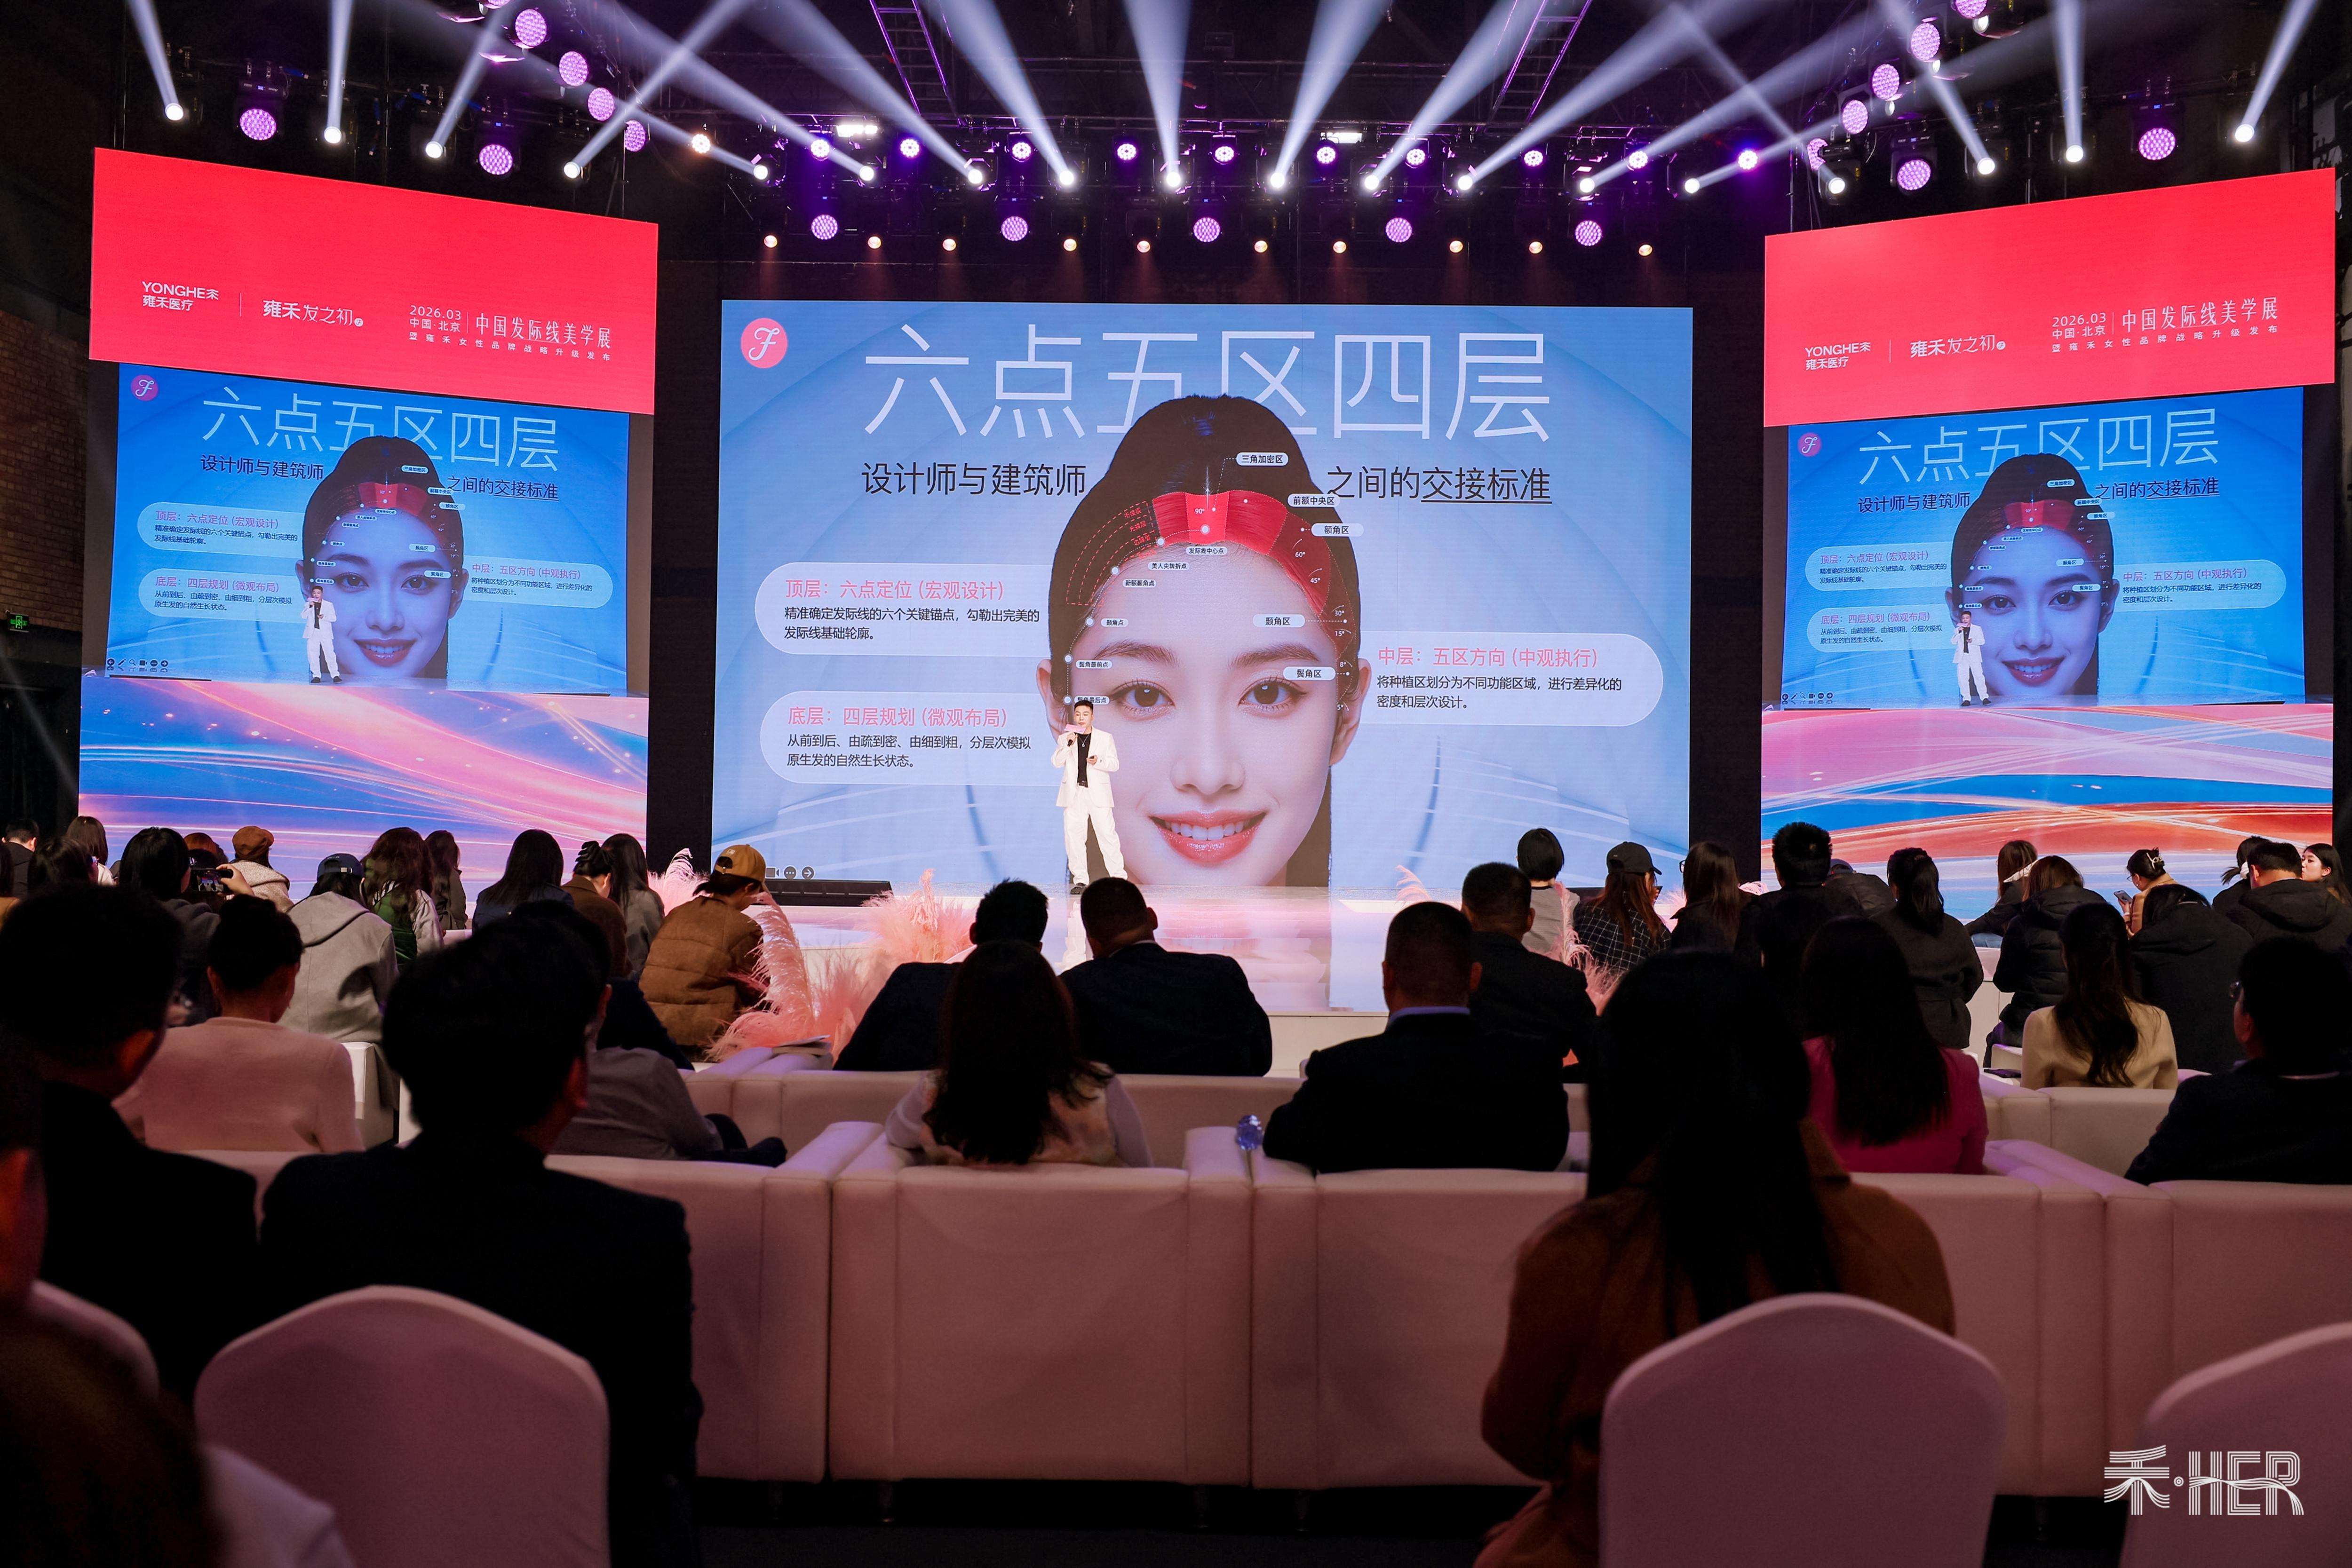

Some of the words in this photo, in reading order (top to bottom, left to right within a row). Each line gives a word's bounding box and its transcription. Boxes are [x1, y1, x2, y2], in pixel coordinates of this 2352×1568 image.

[142, 281, 206, 300] YONGHE
[143, 295, 193, 311] 雍禾医疗
[262, 300, 353, 326] 雍禾发之初
[410, 305, 461, 320] 2026.03
[2052, 312, 2106, 328] 2026.03
[2122, 296, 2278, 333] 中国发际线美学展
[410, 317, 461, 333] 中国·北京
[476, 312, 611, 349] 中国发际线美学展
[2052, 325, 2106, 340] 中国·北京
[1804, 342, 1859, 357] YONGHE
[1910, 334, 1995, 358] 雍禾发之初
[1805, 356, 1849, 371] 雍禾医疗
[864, 323, 1551, 443] 六点五区四层
[202, 386, 559, 472] 六点五区四层
[1859, 408, 2218, 485] 六点五区四层
[1241, 455, 1283, 464] 三角加密区
[201, 454, 325, 481] 设计师与建筑师
[447, 475, 558, 500] 之间的交接标准
[862, 462, 1086, 497] 设计师与建筑师
[1327, 466, 1552, 501] 之间的交接标准
[1293, 496, 1335, 505] 前额中央区
[1857, 491, 1971, 514] 设计师与建筑师
[2095, 476, 2219, 500] 之间的交接标准
[1324, 525, 1349, 534] 额角区
[471, 586, 517, 595] 密度和层次设计。
[154, 602, 227, 611] 原生发的自然生长状态。
[2122, 595, 2173, 604] 密度和层次设计。
[784, 607, 1040, 623] 精准确定发际线的六个关键锚点，勾勒出完美的
[784, 626, 874, 640] 发际线基础轮廓。
[1820, 636, 1883, 645] 原生发的自然生长状态。
[1296, 669, 1321, 678] 鬓角区
[1377, 675, 1622, 691] 将种植区划分为不同功能区域，进行差异化的
[1377, 695, 1468, 709] 密度和层次设计。
[788, 734, 1031, 750] 从前到后、由疏到密、由细到粗，分层次模拟
[787, 754, 914, 768] 原生发的自然生长状态。
